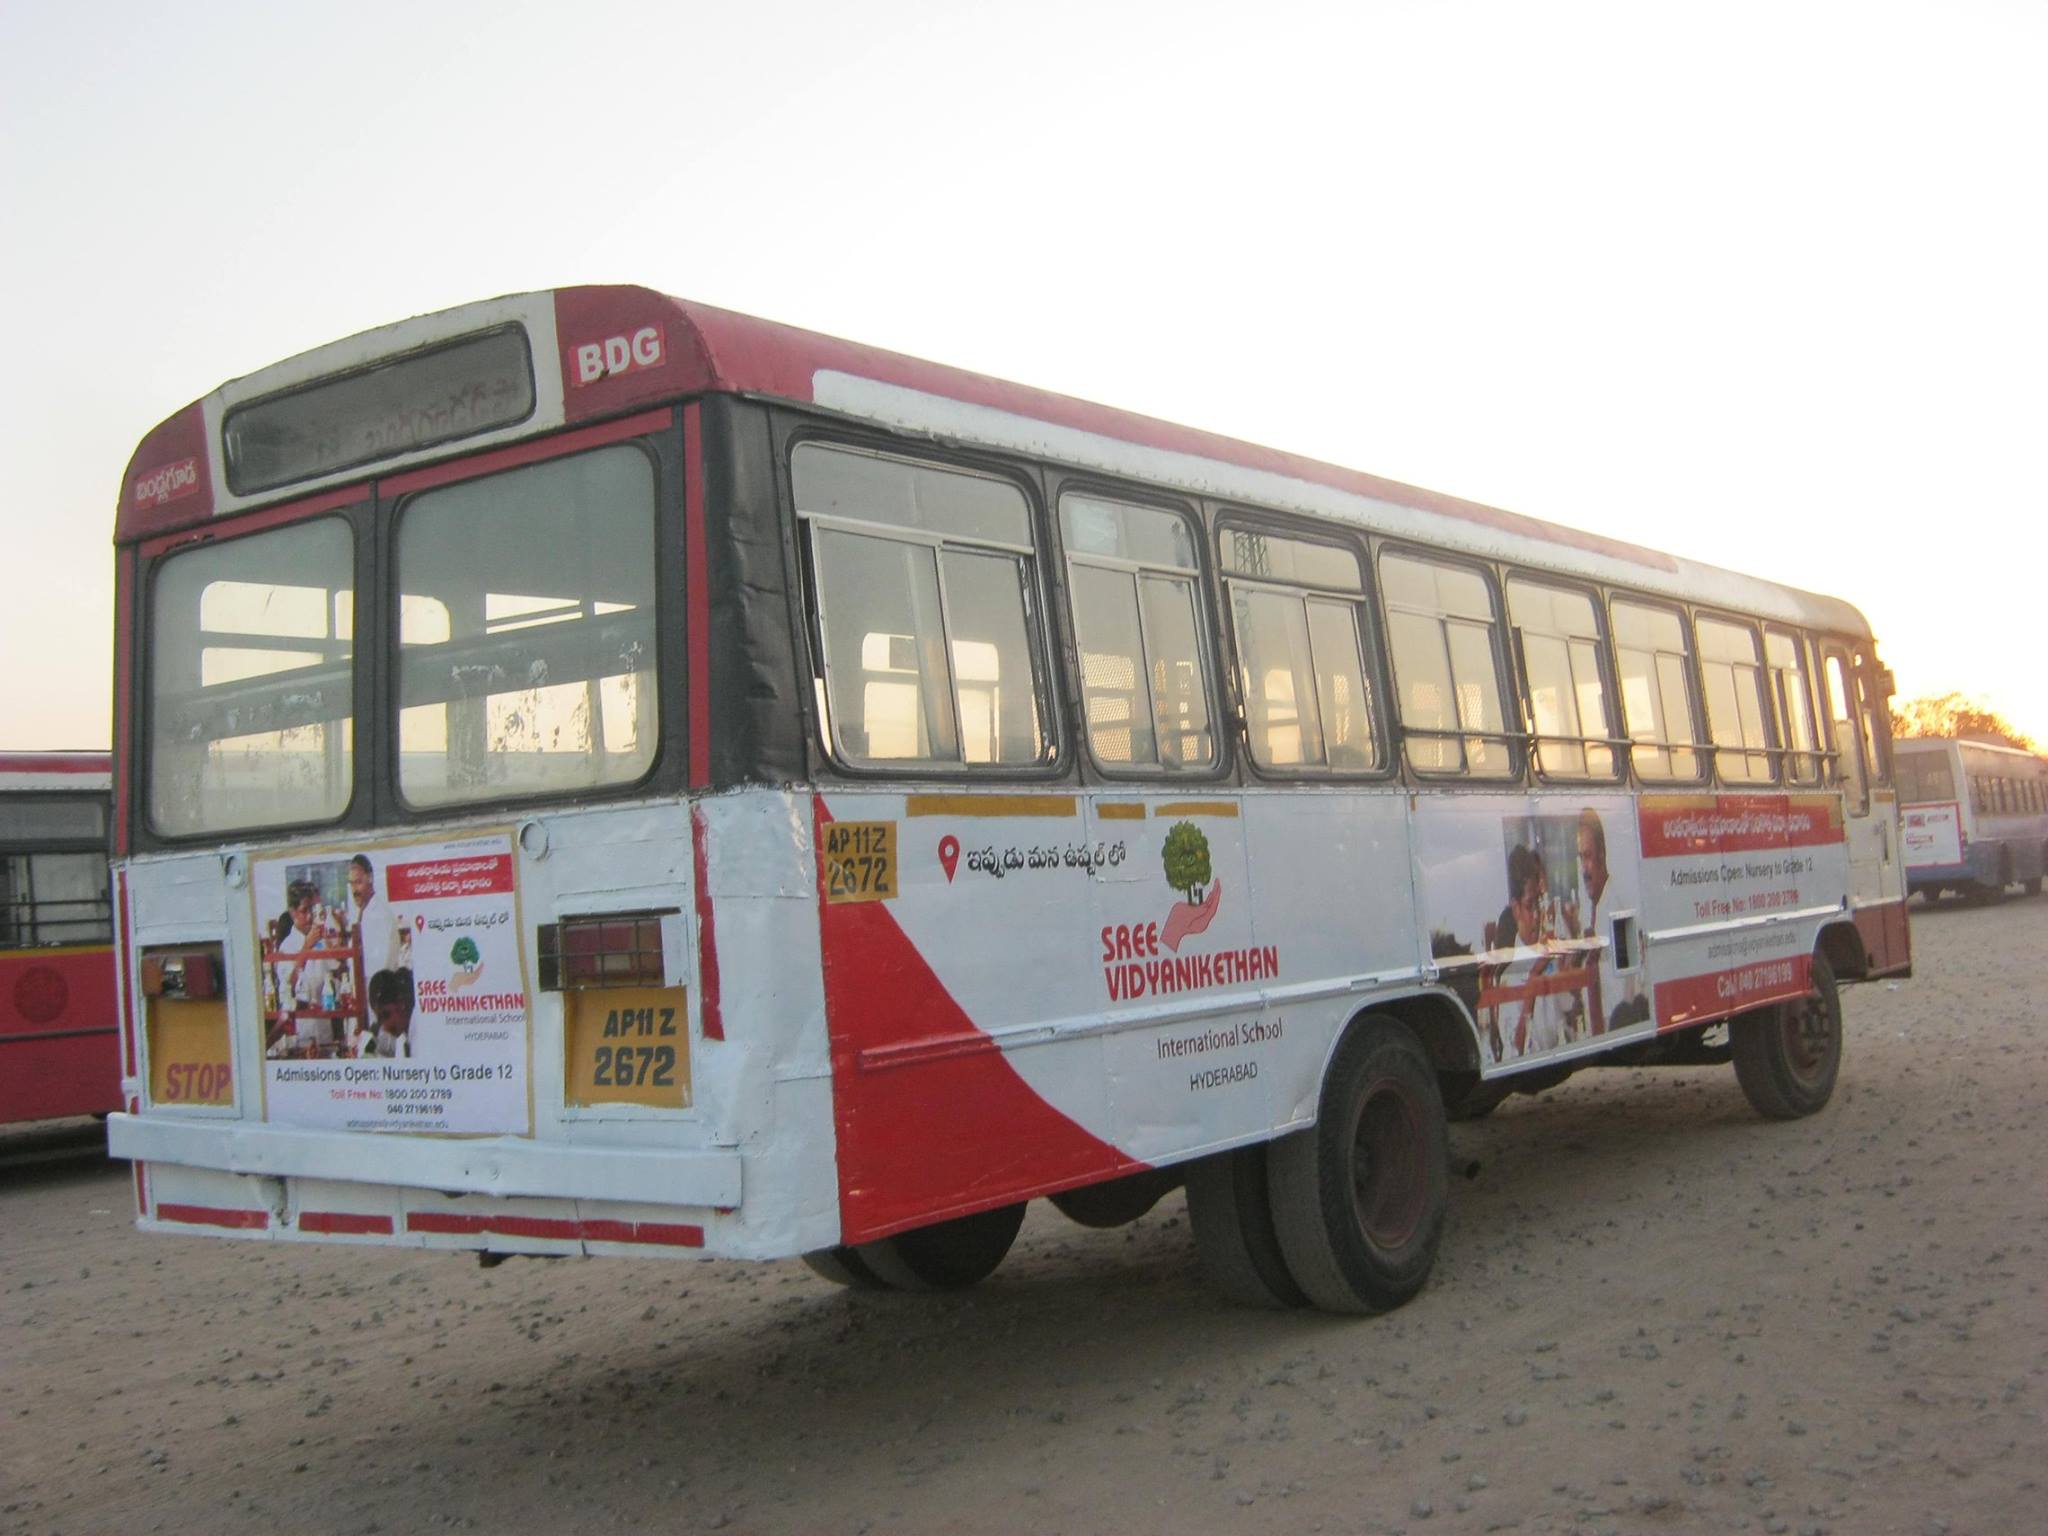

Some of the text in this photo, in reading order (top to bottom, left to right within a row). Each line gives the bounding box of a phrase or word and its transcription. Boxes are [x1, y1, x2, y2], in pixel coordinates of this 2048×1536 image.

[578, 328, 660, 382] BDG
[828, 856, 889, 895] 2672
[967, 846, 1024, 878] ఇప్పుడు
[1028, 846, 1059, 869] మన
[1671, 867, 1719, 886] Admissions
[1745, 862, 1773, 879] Nursery
[1694, 901, 1710, 918] Toll
[1712, 899, 1730, 916] Free
[1101, 921, 1158, 962] SREE
[417, 979, 446, 996] SREE
[1105, 944, 1278, 1001] VIDYANIKETHAN
[419, 992, 525, 1013] VIDYANIKETHAN
[446, 1014, 497, 1025] International
[1157, 1017, 1282, 1059] International School
[276, 1064, 513, 1085] Admissions Open: Nursery to Grade 12
[593, 1045, 675, 1086] 2672
[1190, 1062, 1258, 1091] HYDERABAD
[166, 1063, 232, 1099] STOP
[347, 1089, 367, 1100] Free
